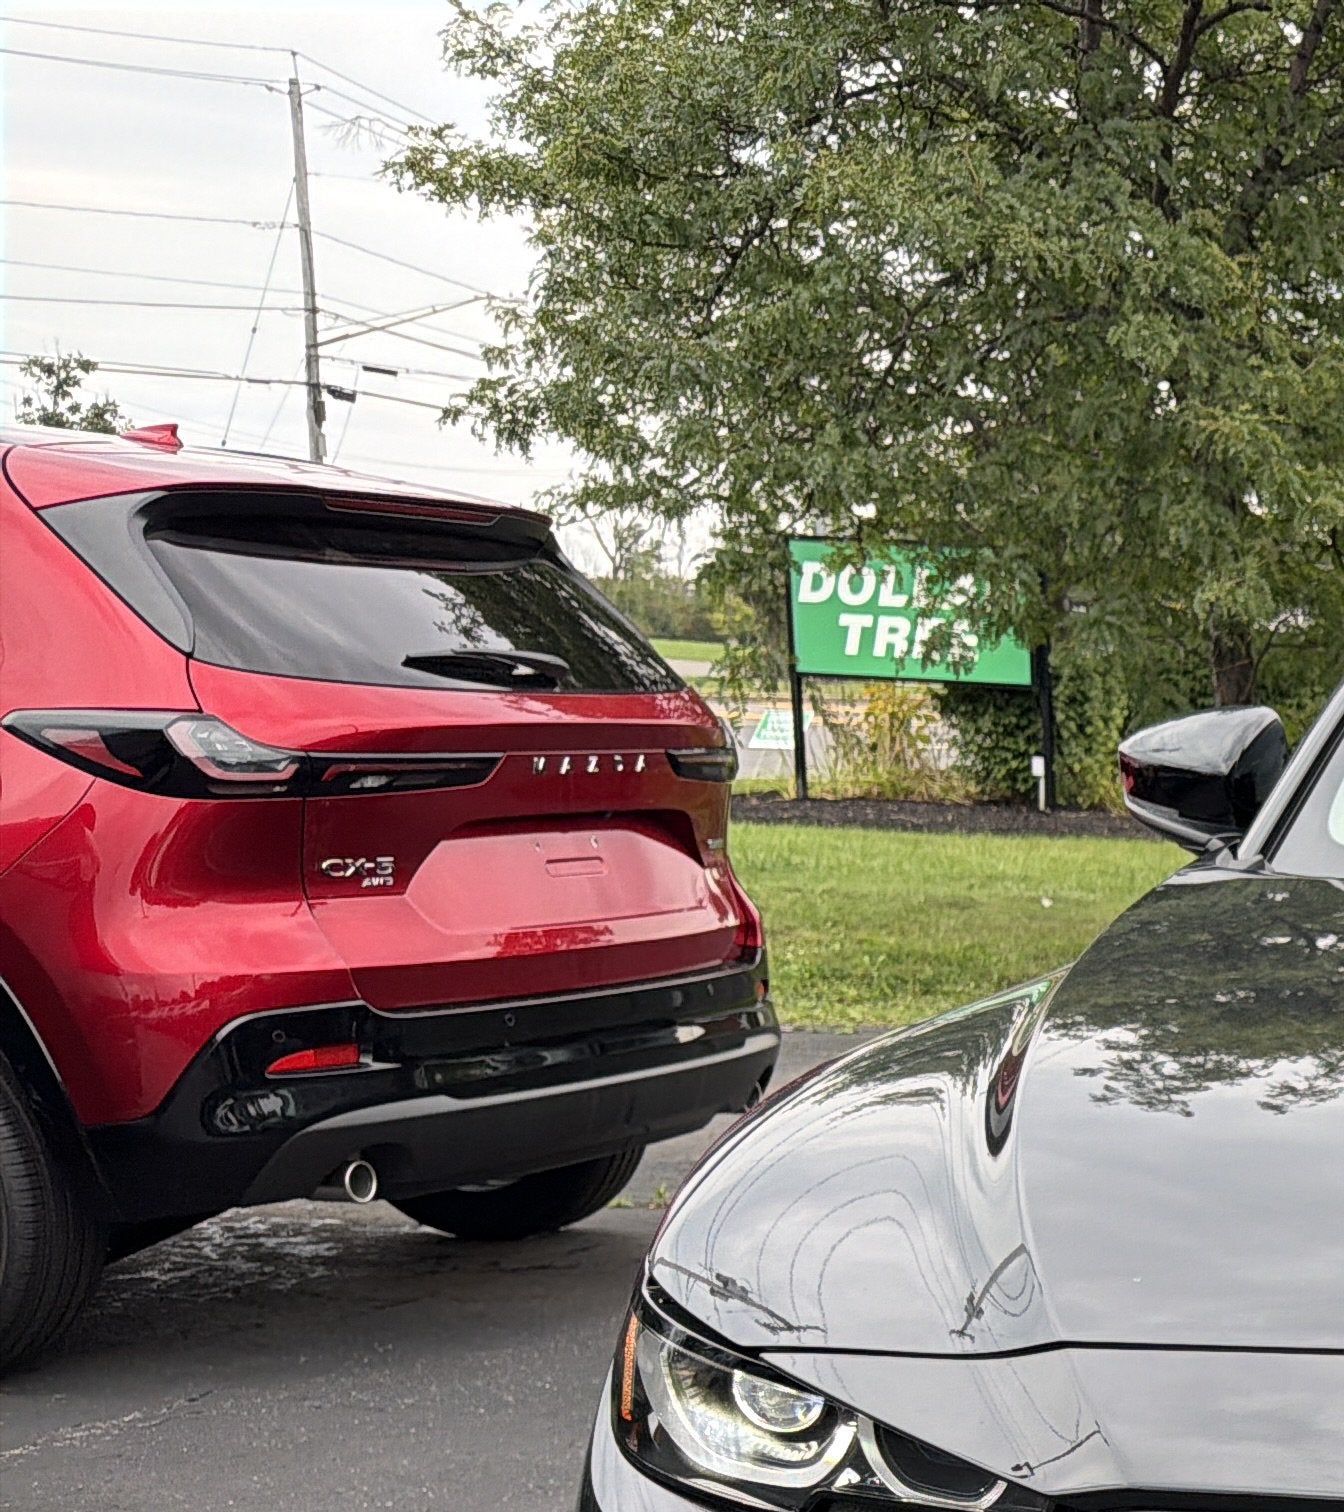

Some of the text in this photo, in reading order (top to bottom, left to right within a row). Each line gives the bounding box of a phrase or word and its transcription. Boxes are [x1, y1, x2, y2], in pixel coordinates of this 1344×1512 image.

[798, 561, 1002, 611] DOLL
[532, 754, 646, 774] MAZDA
[321, 856, 394, 877] CX-5
